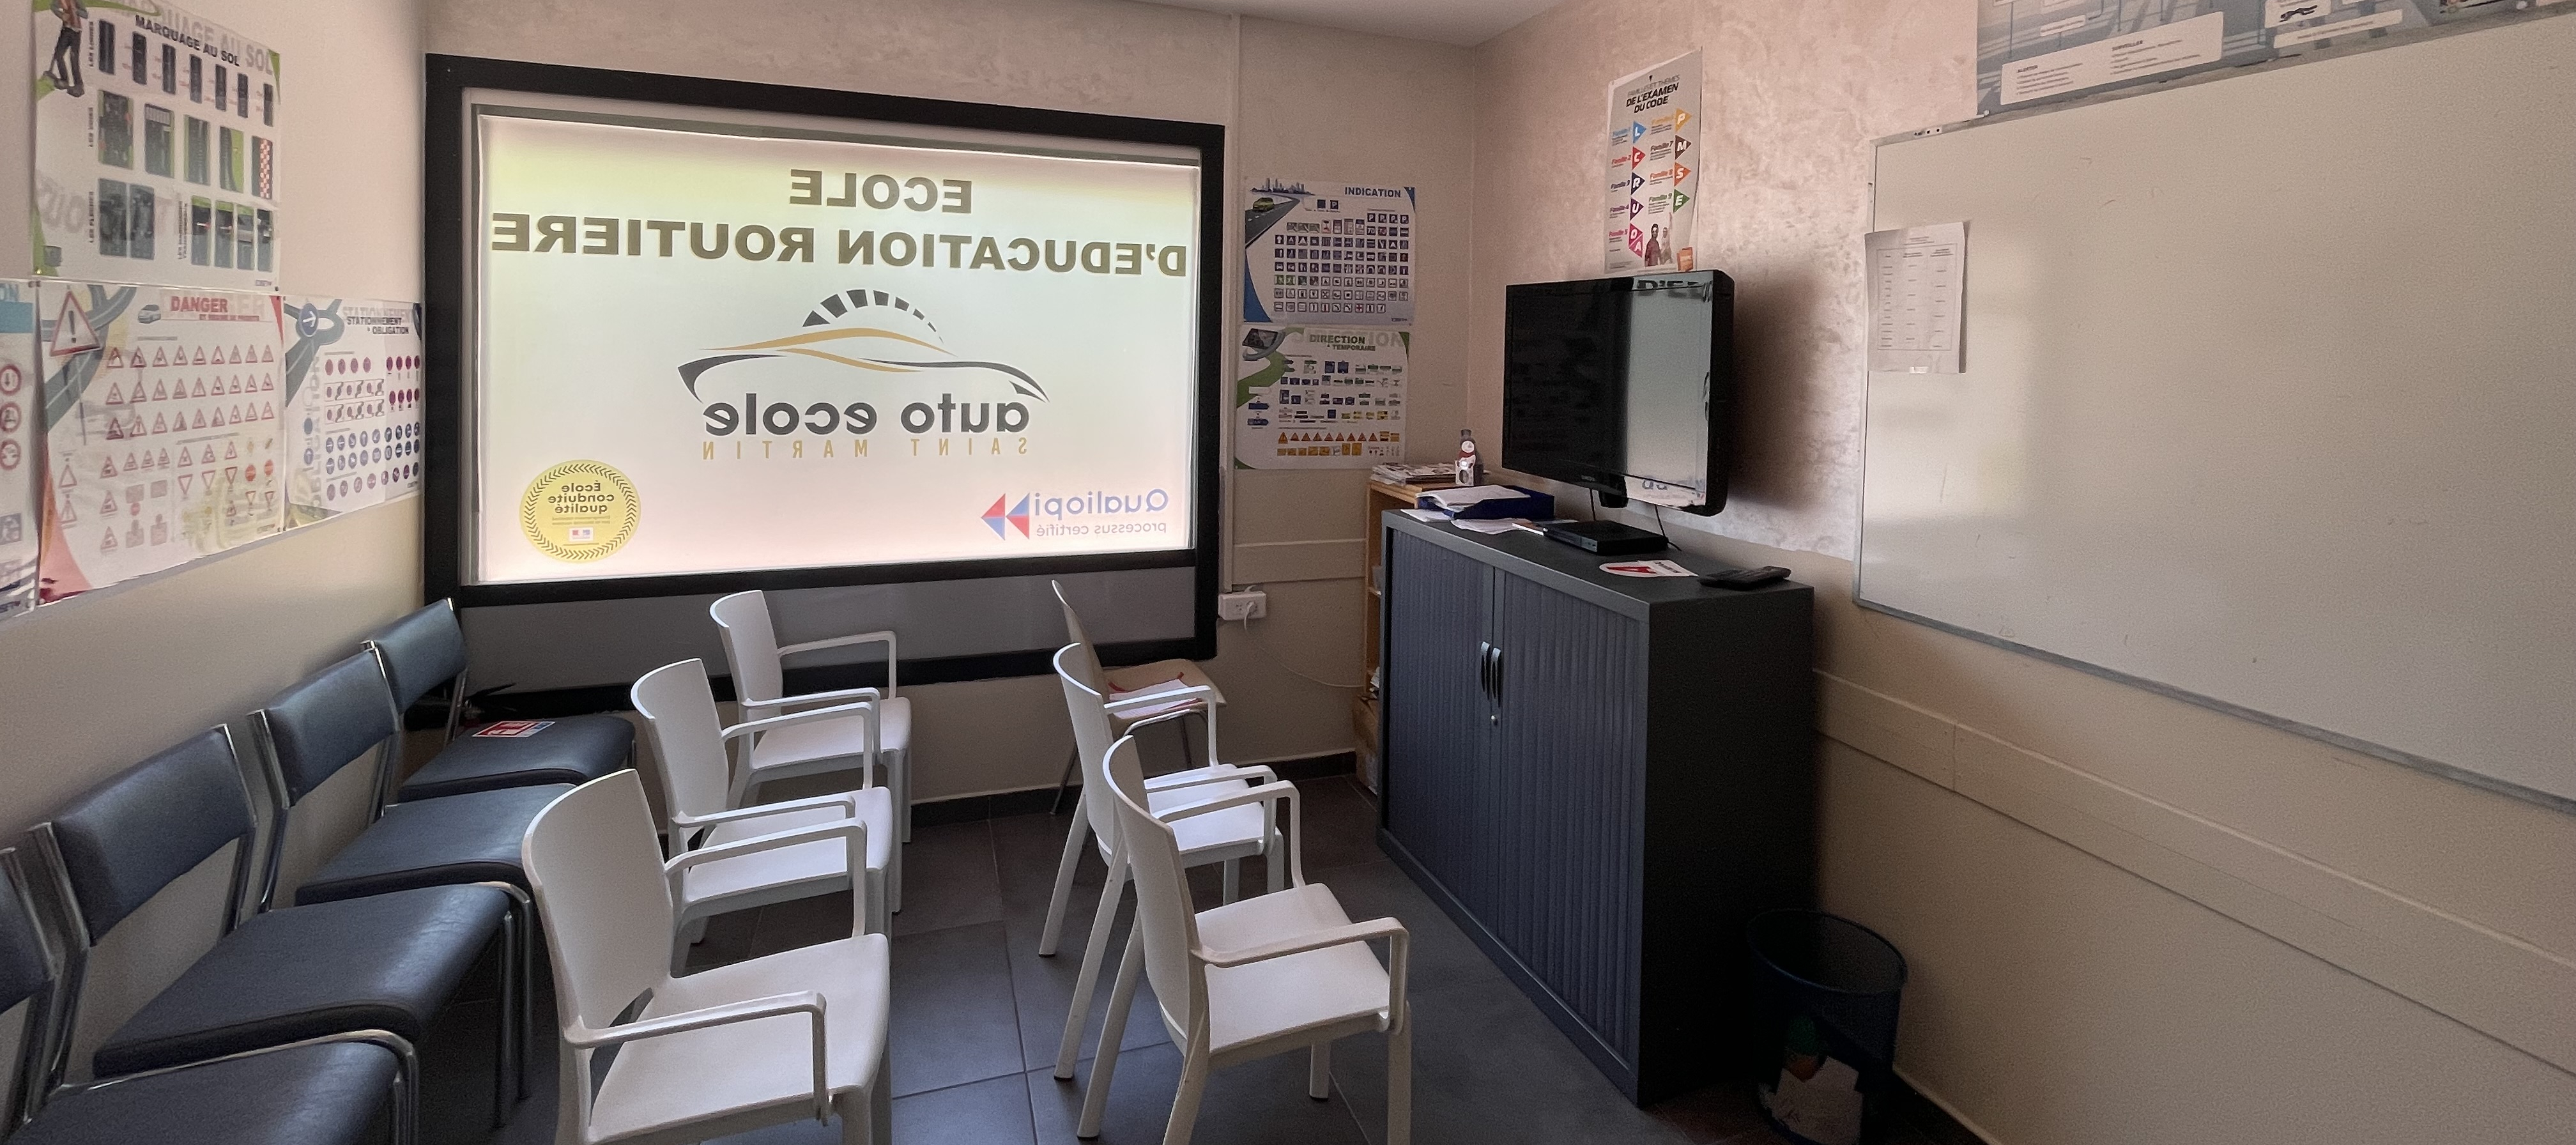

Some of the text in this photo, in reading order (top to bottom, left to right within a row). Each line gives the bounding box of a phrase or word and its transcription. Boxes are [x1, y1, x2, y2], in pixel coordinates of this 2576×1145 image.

[135, 14, 240, 66] MARQUAGE AU SOL
[1626, 82, 1679, 107] DE L'EXAMEN
[1634, 95, 1669, 114] DU CODE
[1634, 127, 1640, 137] L
[1676, 140, 1687, 151] M
[1676, 167, 1684, 179] S
[1632, 177, 1641, 188] R
[1344, 187, 1401, 198] INDICATION
[1675, 194, 1683, 206] E
[1632, 203, 1639, 213] U
[1634, 241, 1642, 252] A
[171, 295, 228, 312] DANGER
[1310, 334, 1365, 344] DIRECTION
